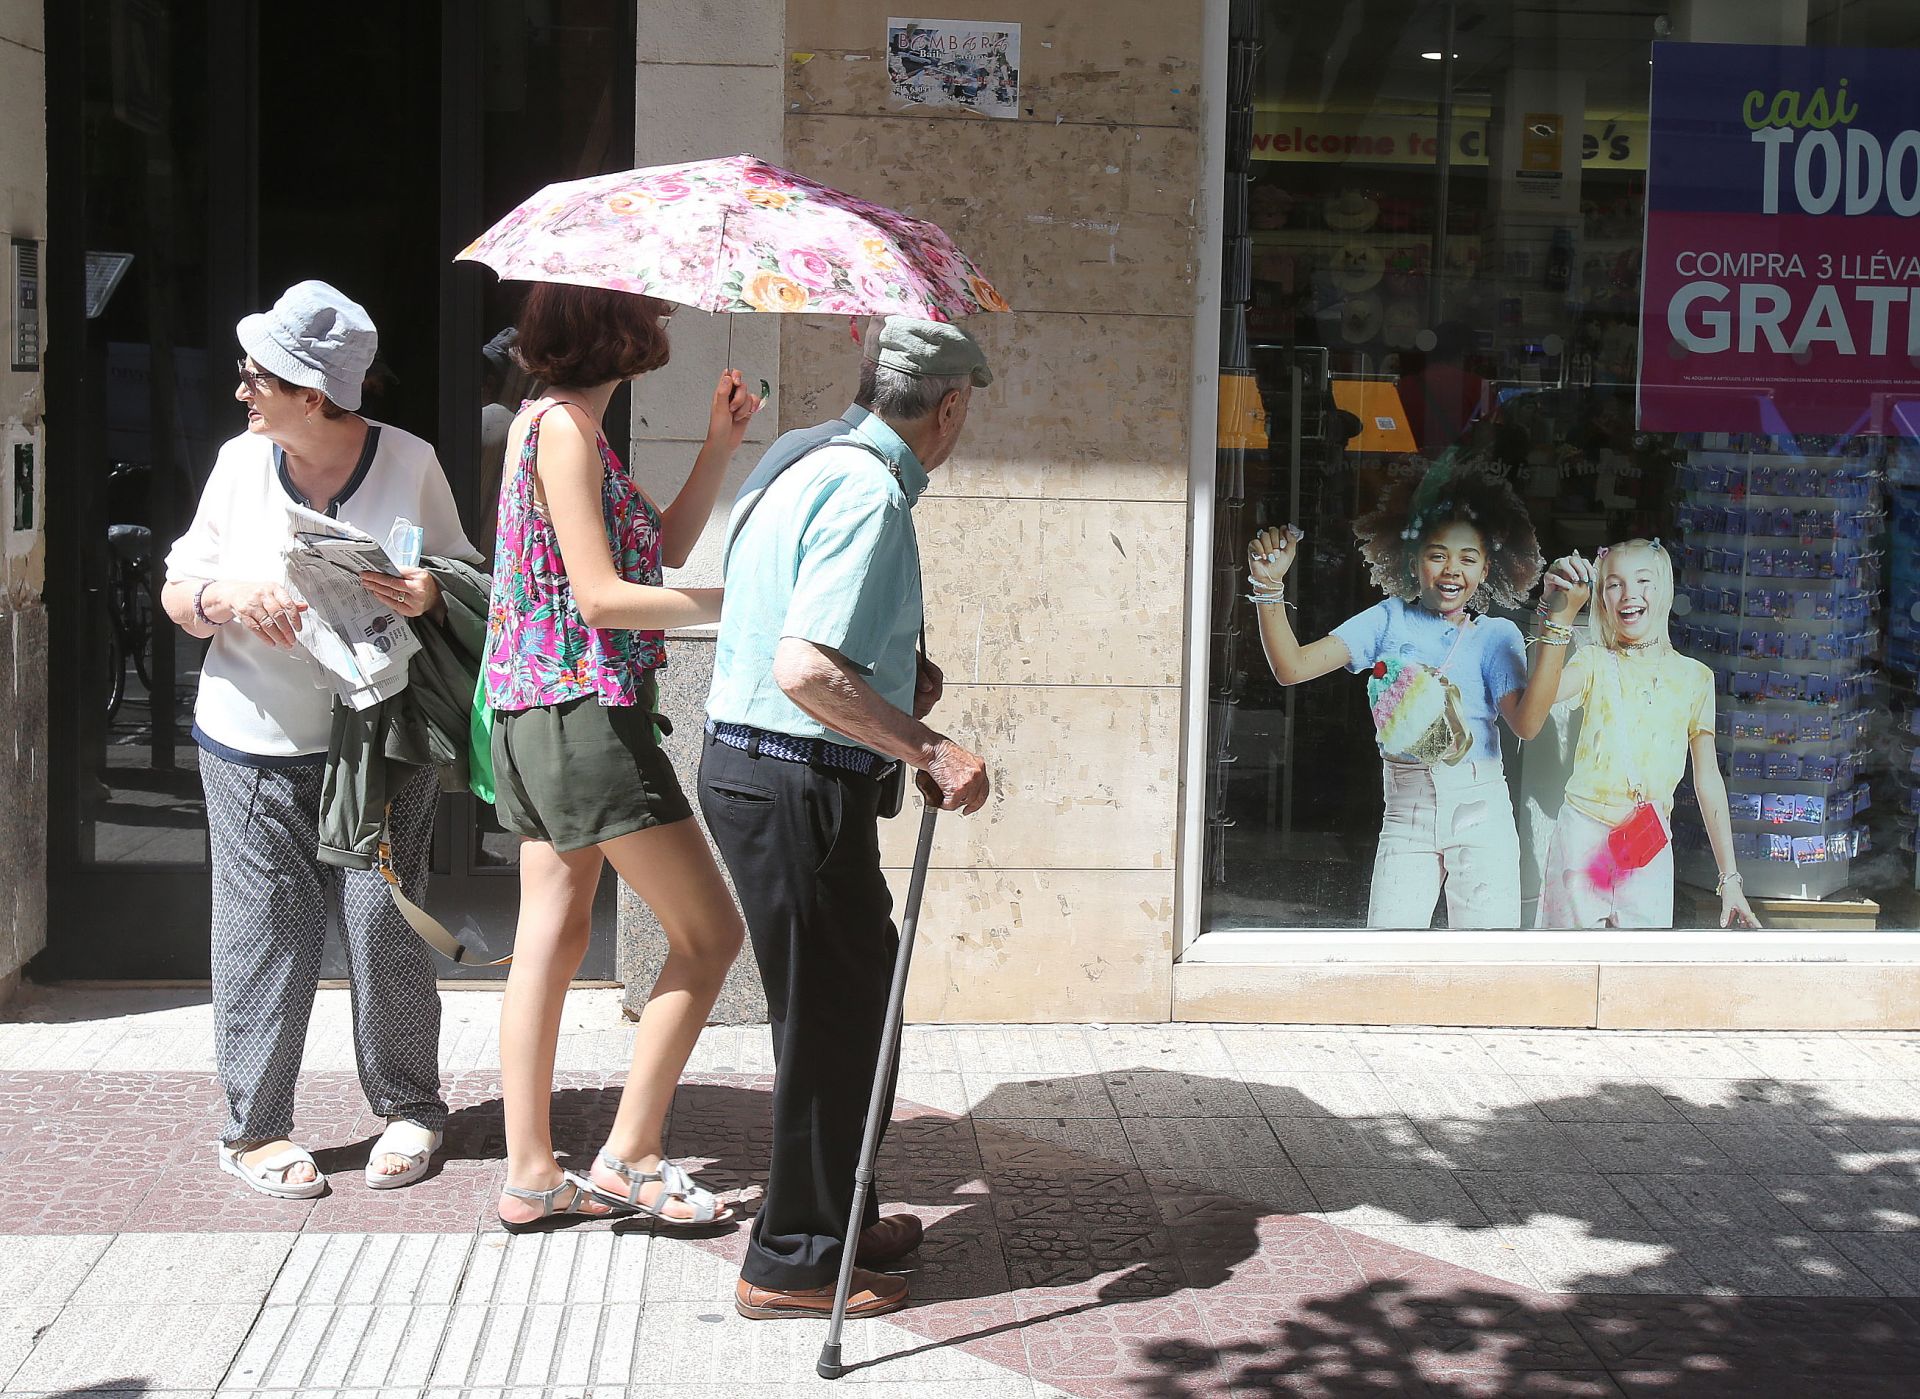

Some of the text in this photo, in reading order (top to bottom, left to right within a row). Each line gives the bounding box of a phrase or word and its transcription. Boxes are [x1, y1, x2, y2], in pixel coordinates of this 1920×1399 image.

[1743, 78, 1858, 130] casi
[1252, 127, 1394, 156] welcome
[1751, 127, 1920, 217] TODO
[1676, 251, 1806, 278] COMPRA
[1816, 253, 1833, 279] 3
